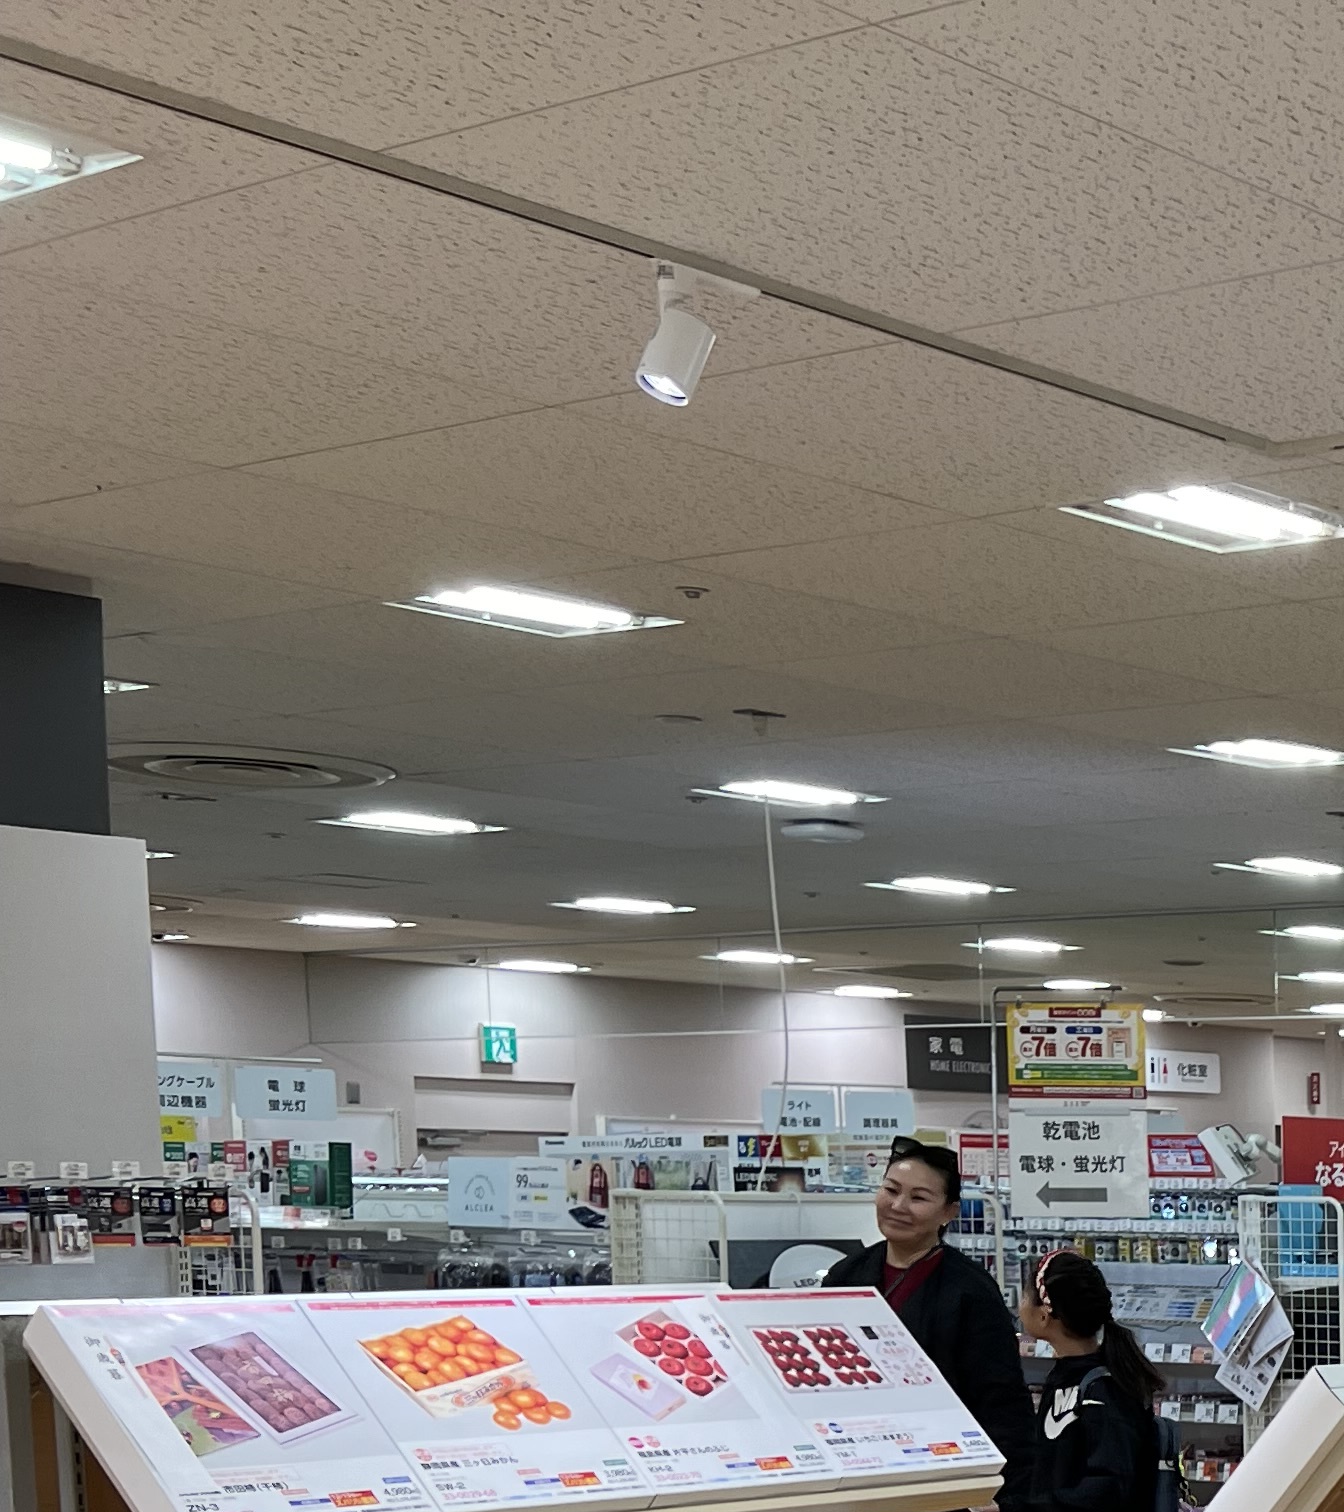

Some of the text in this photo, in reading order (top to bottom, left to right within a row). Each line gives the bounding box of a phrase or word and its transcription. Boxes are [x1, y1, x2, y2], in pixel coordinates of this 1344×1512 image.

[929, 1036, 963, 1055] 家電
[930, 1059, 993, 1075] HOME ELECTRONIC
[1177, 1062, 1208, 1078] 化粧室
[268, 1099, 307, 1112] 蛍光灯
[787, 1101, 812, 1111] ライト
[1042, 1121, 1101, 1141] 乾電池
[1019, 1154, 1126, 1174] 電球・蛍光灯
